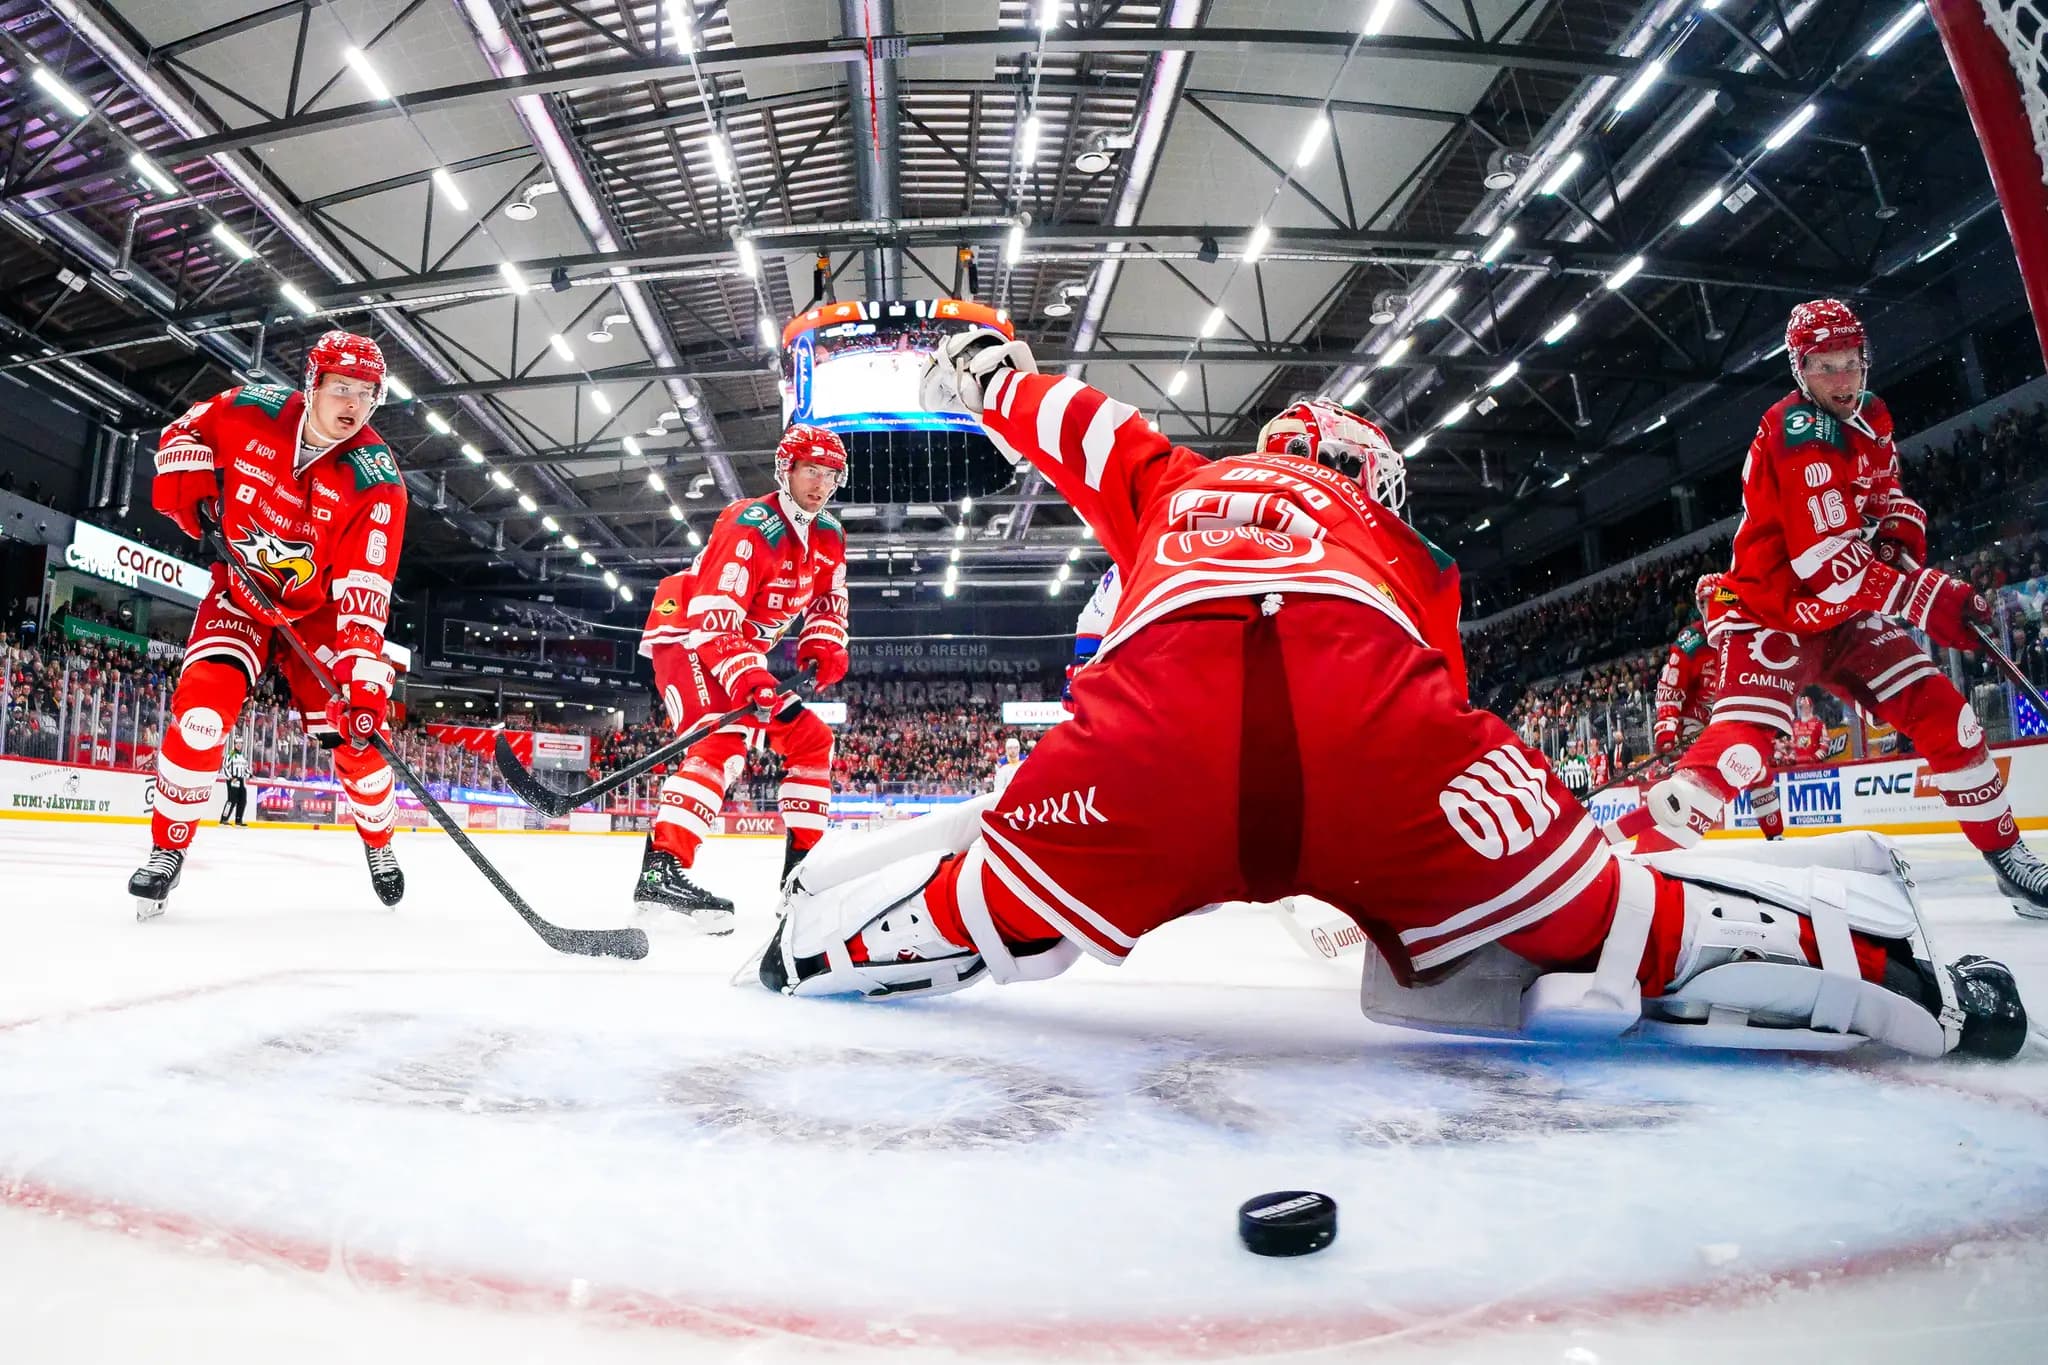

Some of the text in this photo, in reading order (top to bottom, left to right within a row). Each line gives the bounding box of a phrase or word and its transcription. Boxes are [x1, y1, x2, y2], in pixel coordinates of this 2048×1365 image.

[158, 450, 212, 467] WARRIOR
[256, 444, 276, 460] KPO
[1220, 467, 1332, 511] ORTIO
[1808, 488, 1847, 534] 16
[366, 529, 387, 566] 6
[65, 544, 138, 588] Caverion
[117, 546, 184, 587] carrot
[205, 619, 262, 646] CAMLINE
[876, 643, 923, 657] SÄHKÖ
[929, 644, 988, 657] AREENA
[688, 649, 711, 707] SYKETEC
[1739, 672, 1795, 695] CAMLINE
[1787, 782, 1841, 812] MTM
[1855, 773, 1913, 797] CNC
